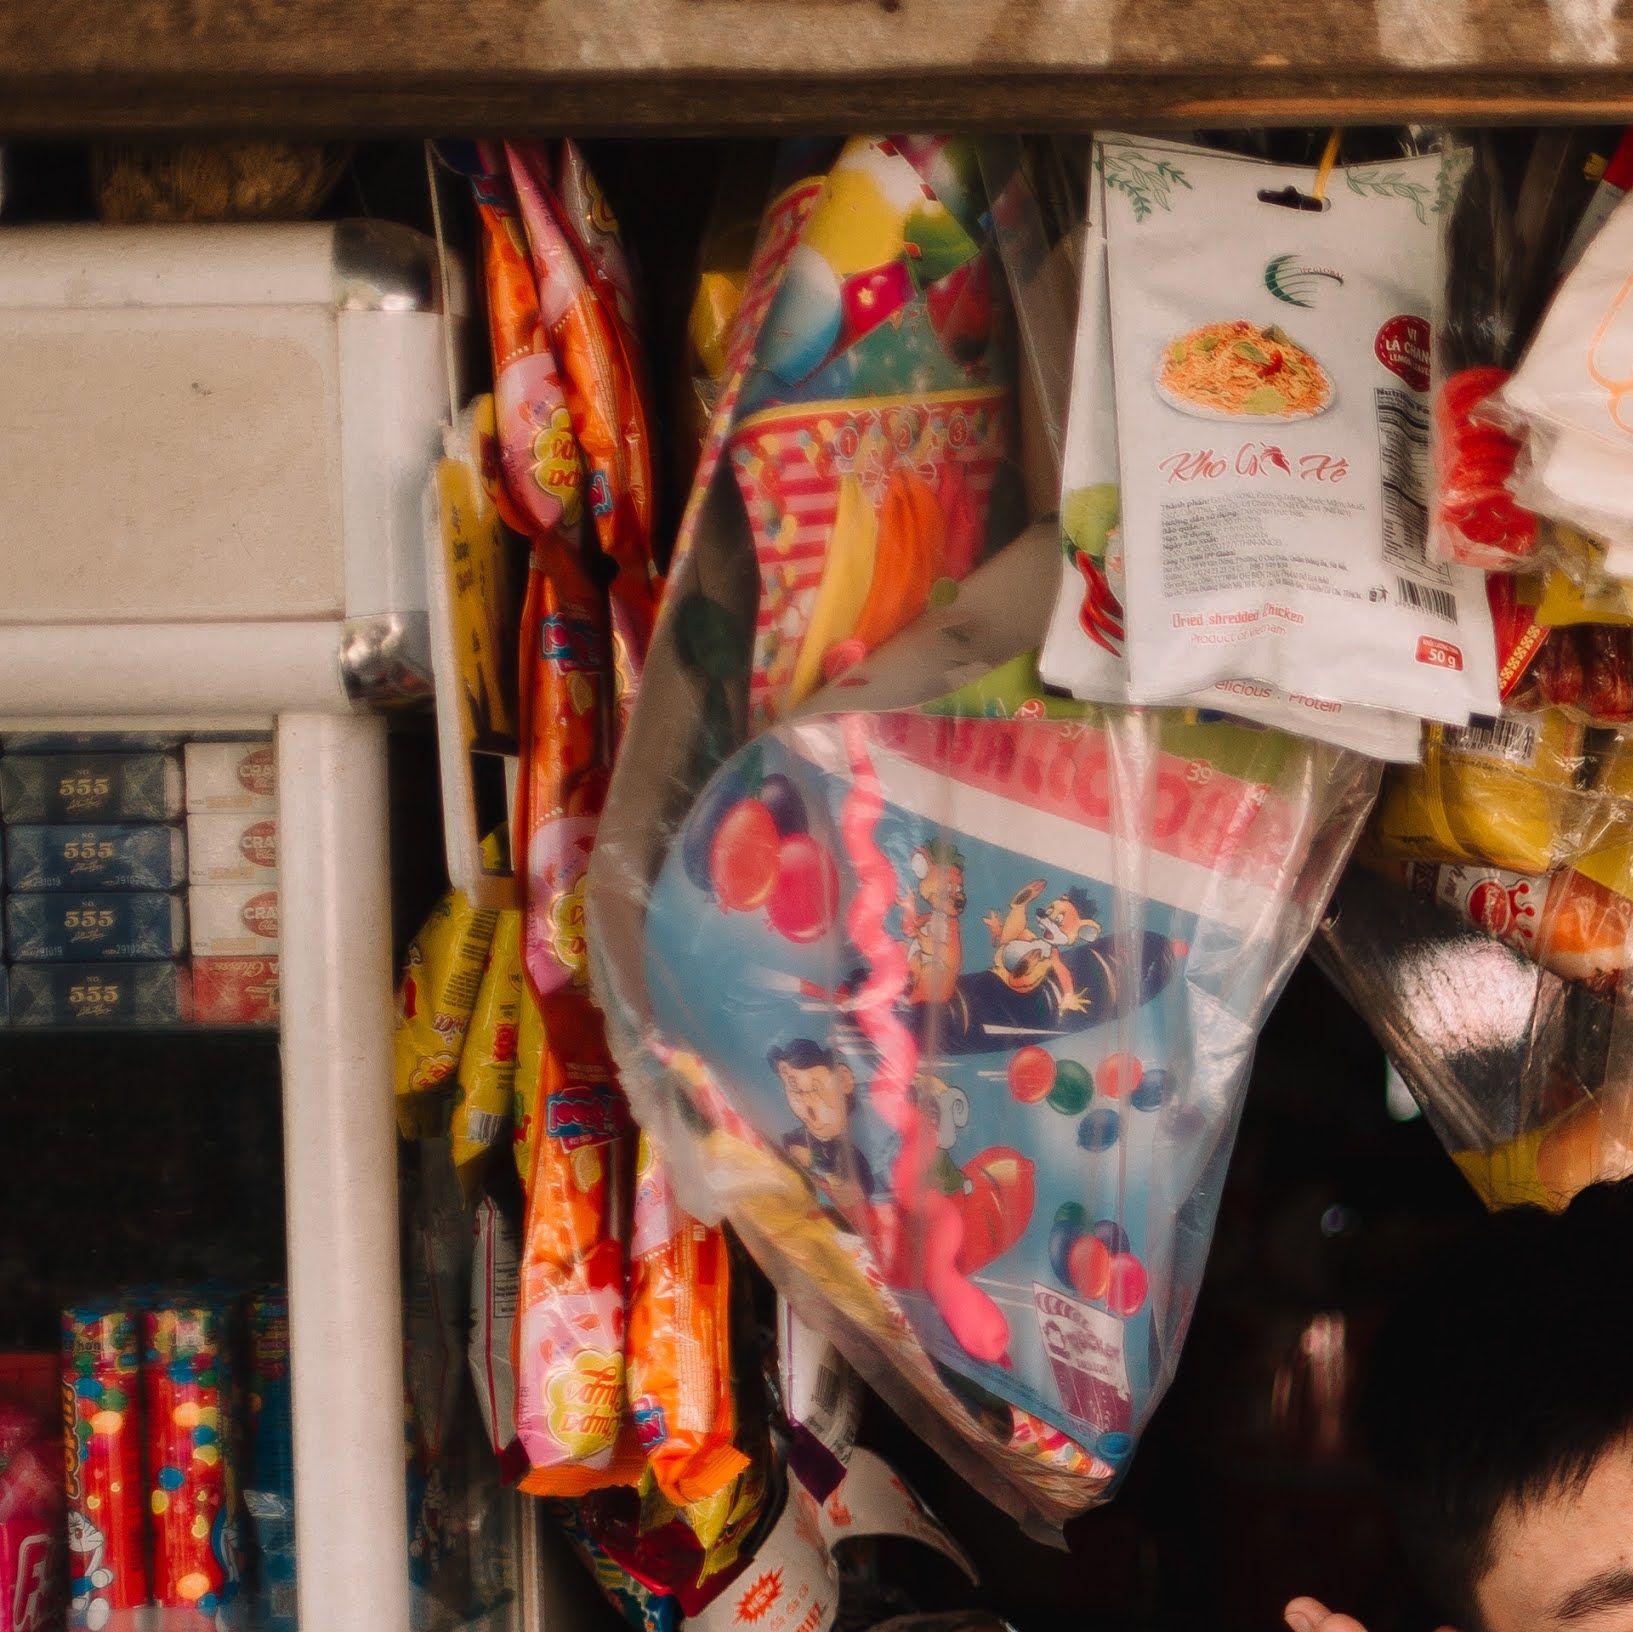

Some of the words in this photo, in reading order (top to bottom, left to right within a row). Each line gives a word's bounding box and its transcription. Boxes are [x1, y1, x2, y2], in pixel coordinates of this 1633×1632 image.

[1209, 611, 1260, 625] shredded
[1428, 650, 1445, 663] 50
[59, 779, 110, 796] 555
[63, 842, 114, 859] 555
[64, 911, 114, 928] 555
[69, 986, 119, 1003] 555
